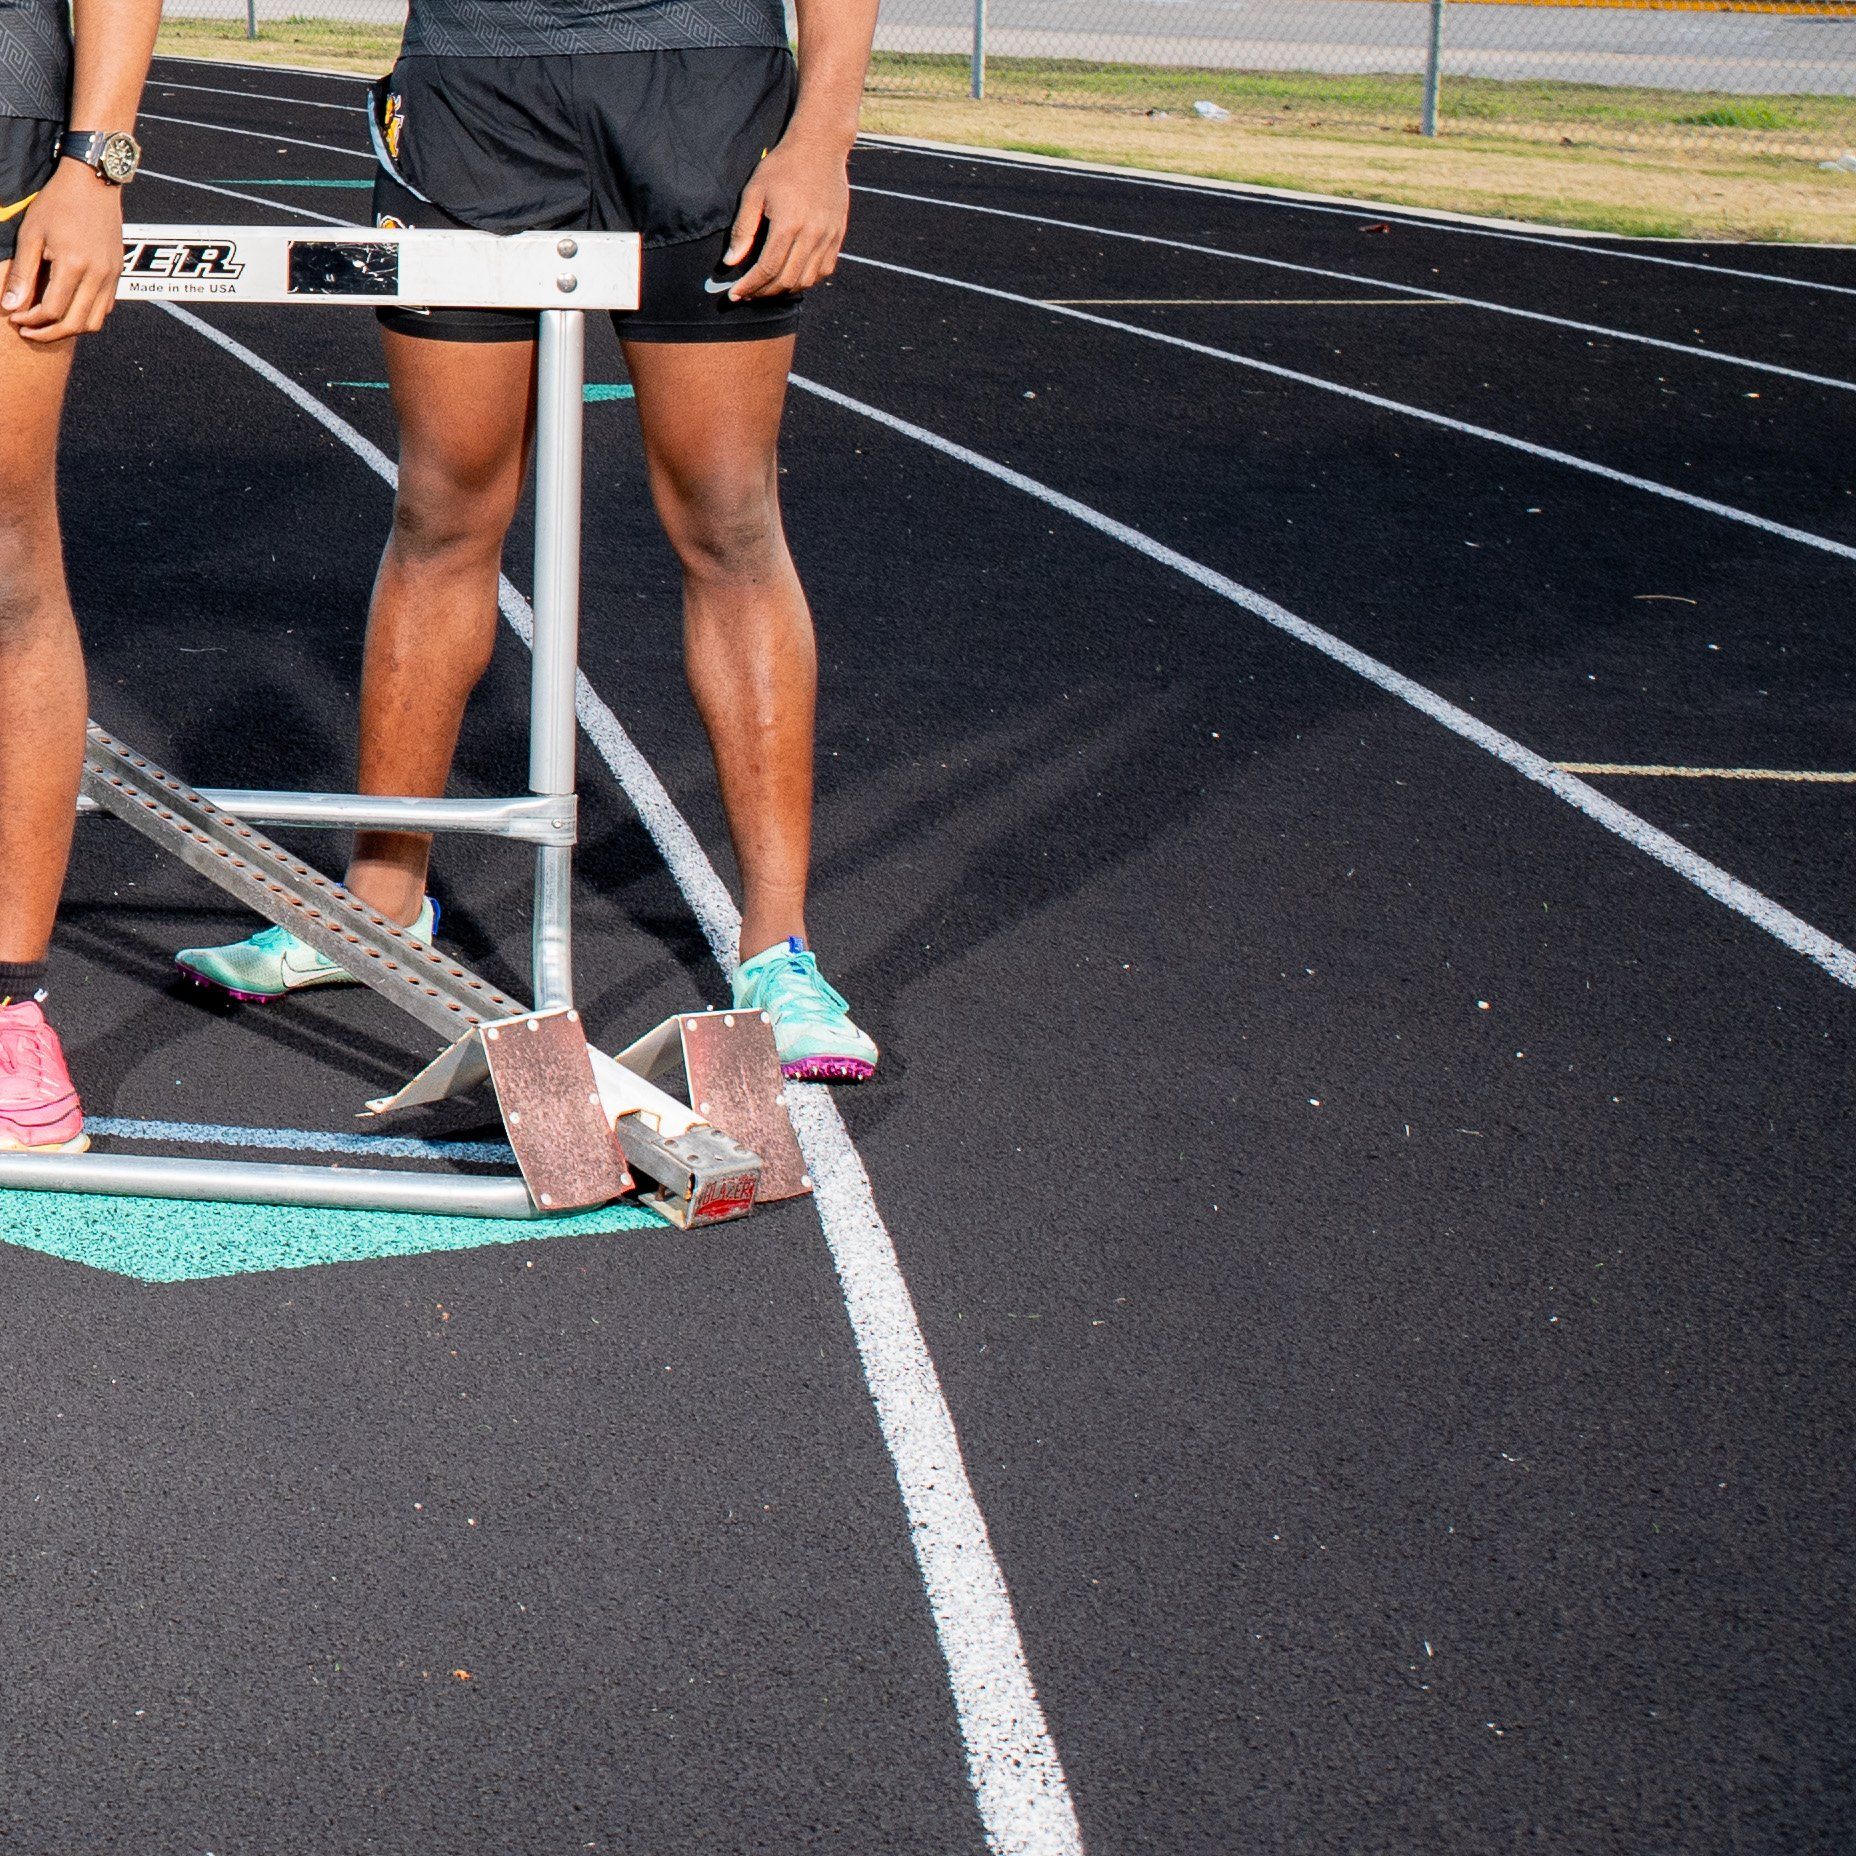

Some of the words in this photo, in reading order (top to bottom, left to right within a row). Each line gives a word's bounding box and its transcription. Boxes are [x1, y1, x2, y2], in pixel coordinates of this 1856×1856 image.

[129, 282, 164, 293] Made
[168, 282, 180, 293] in
[184, 282, 205, 293] the
[209, 283, 237, 294] USA
